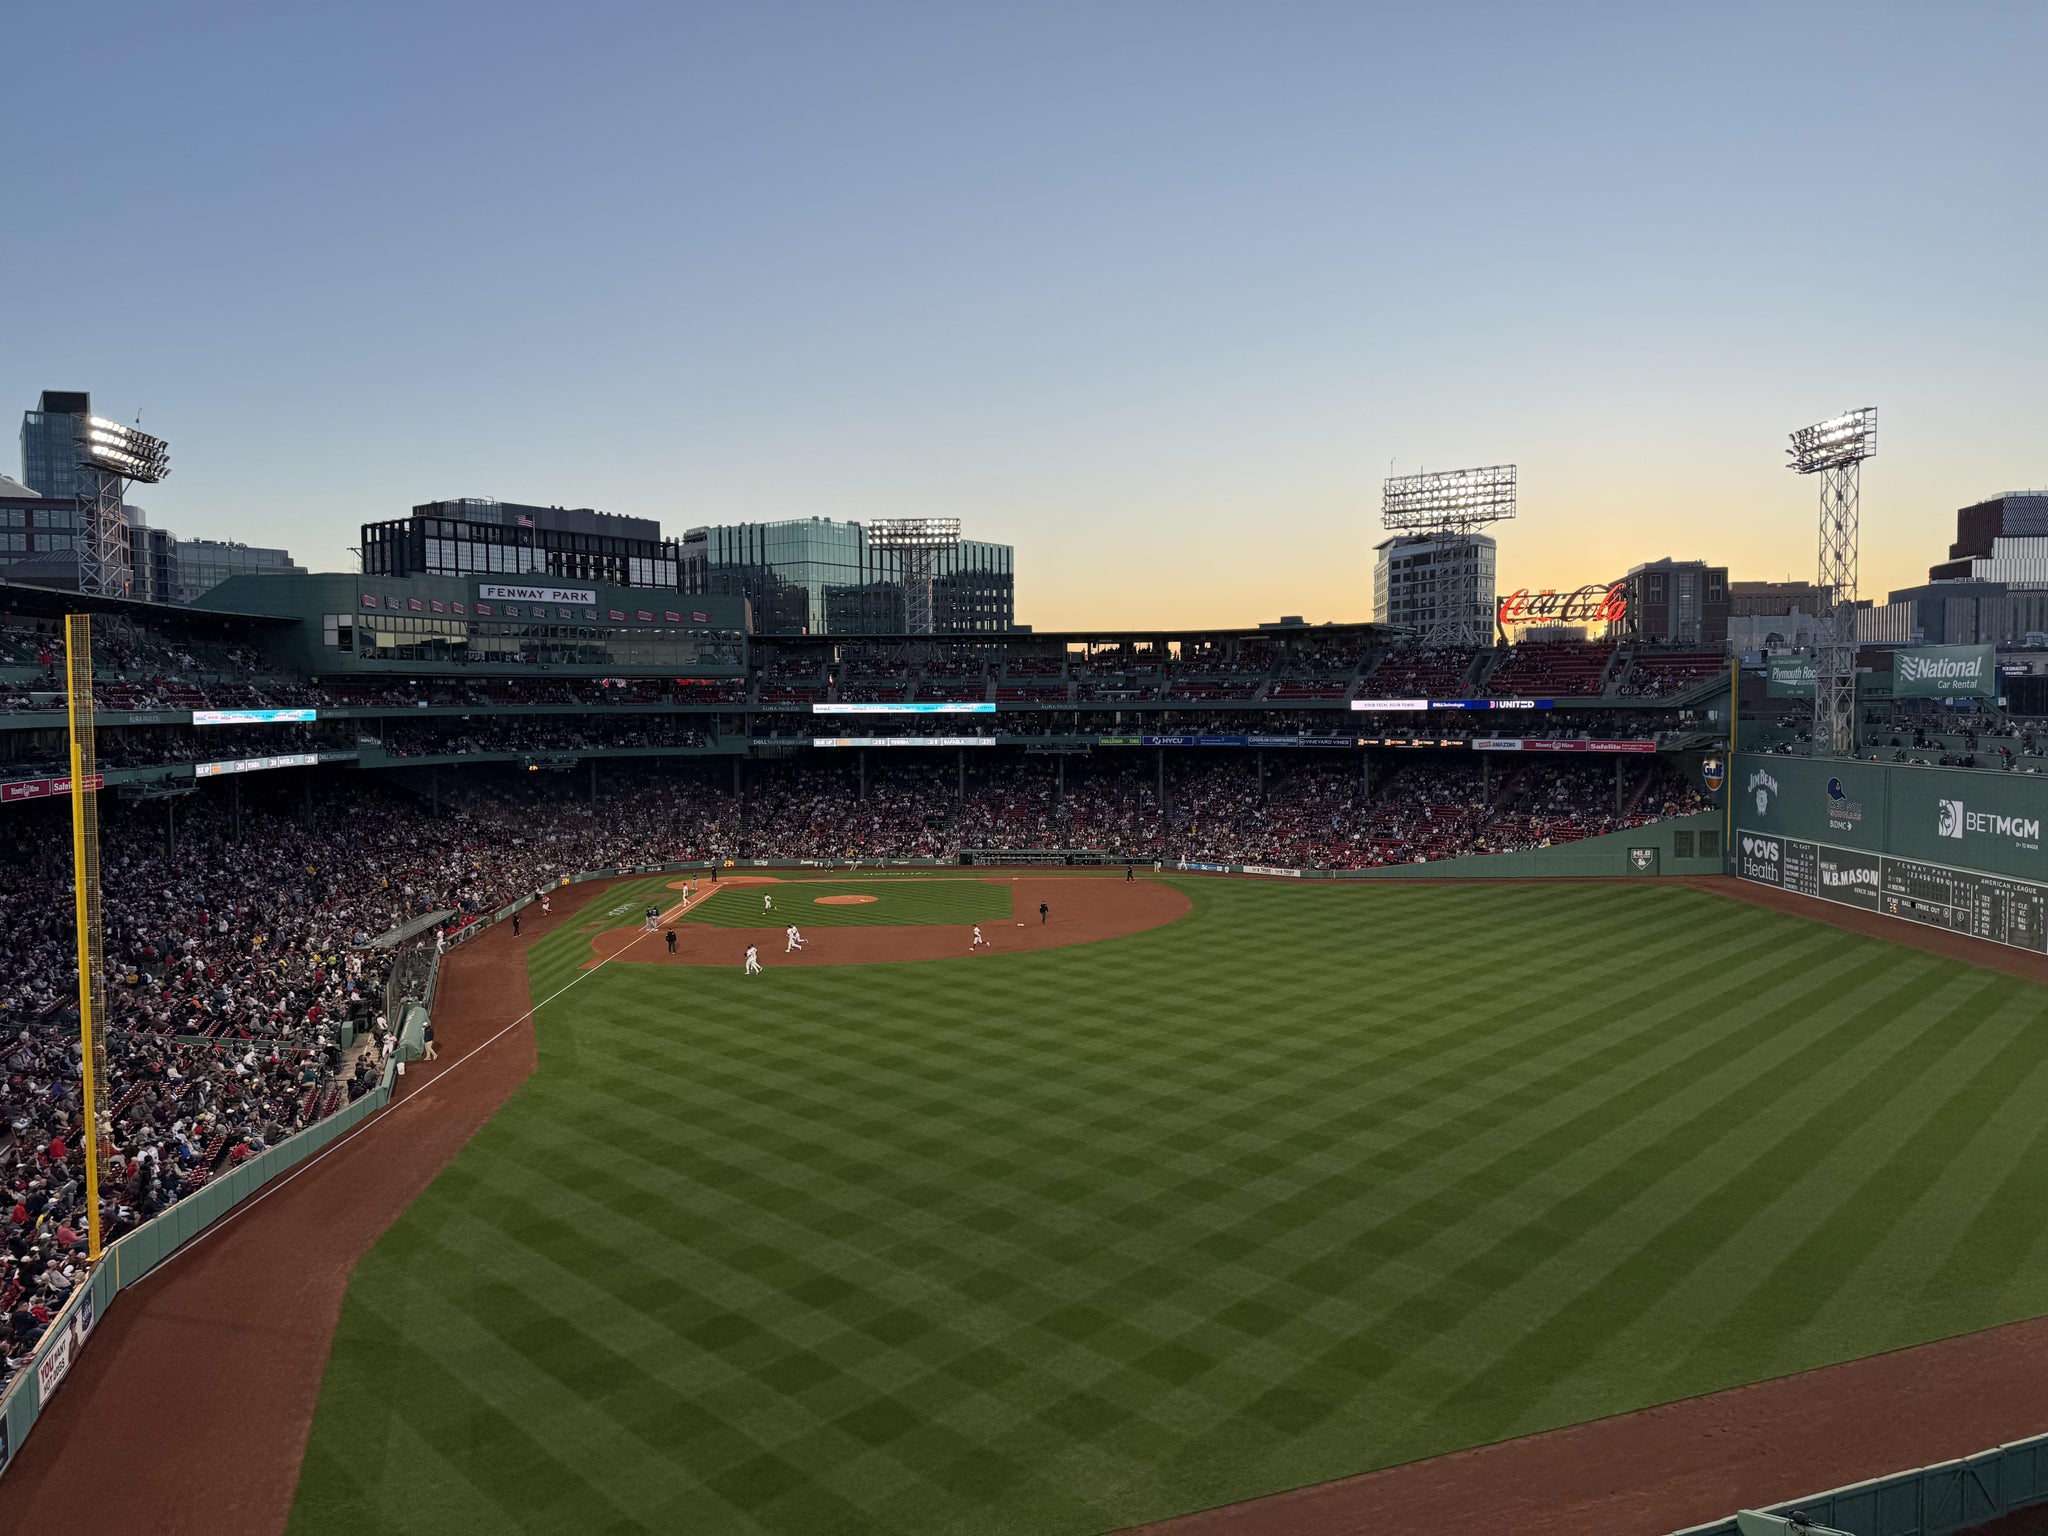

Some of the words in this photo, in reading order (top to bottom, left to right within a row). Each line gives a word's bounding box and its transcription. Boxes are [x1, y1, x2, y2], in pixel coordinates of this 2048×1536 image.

[487, 587, 545, 598] FENWAY
[552, 591, 589, 602] PARK
[1772, 666, 1802, 680] Plymouth
[1803, 666, 1817, 678] Roc
[1937, 680, 1950, 689] Car
[1952, 680, 1977, 688] Rental
[1703, 762, 1723, 777] Gulf
[1760, 768, 1778, 797] BEAM
[1966, 812, 2040, 840] BETMGM
[1754, 839, 1779, 862] CVS
[1744, 856, 1779, 882] Health
[1897, 862, 1926, 872] FENWAY
[1932, 869, 1952, 878] PARK
[1892, 884, 1905, 892] BOSTON
[1980, 878, 2010, 889] AMERICAN
[2013, 884, 2037, 894] LEAGUE
[1915, 903, 1929, 912] STRIKE
[40, 1356, 55, 1384] YOU
[44, 1374, 53, 1394] HOT
[53, 1358, 65, 1381] DOGS
